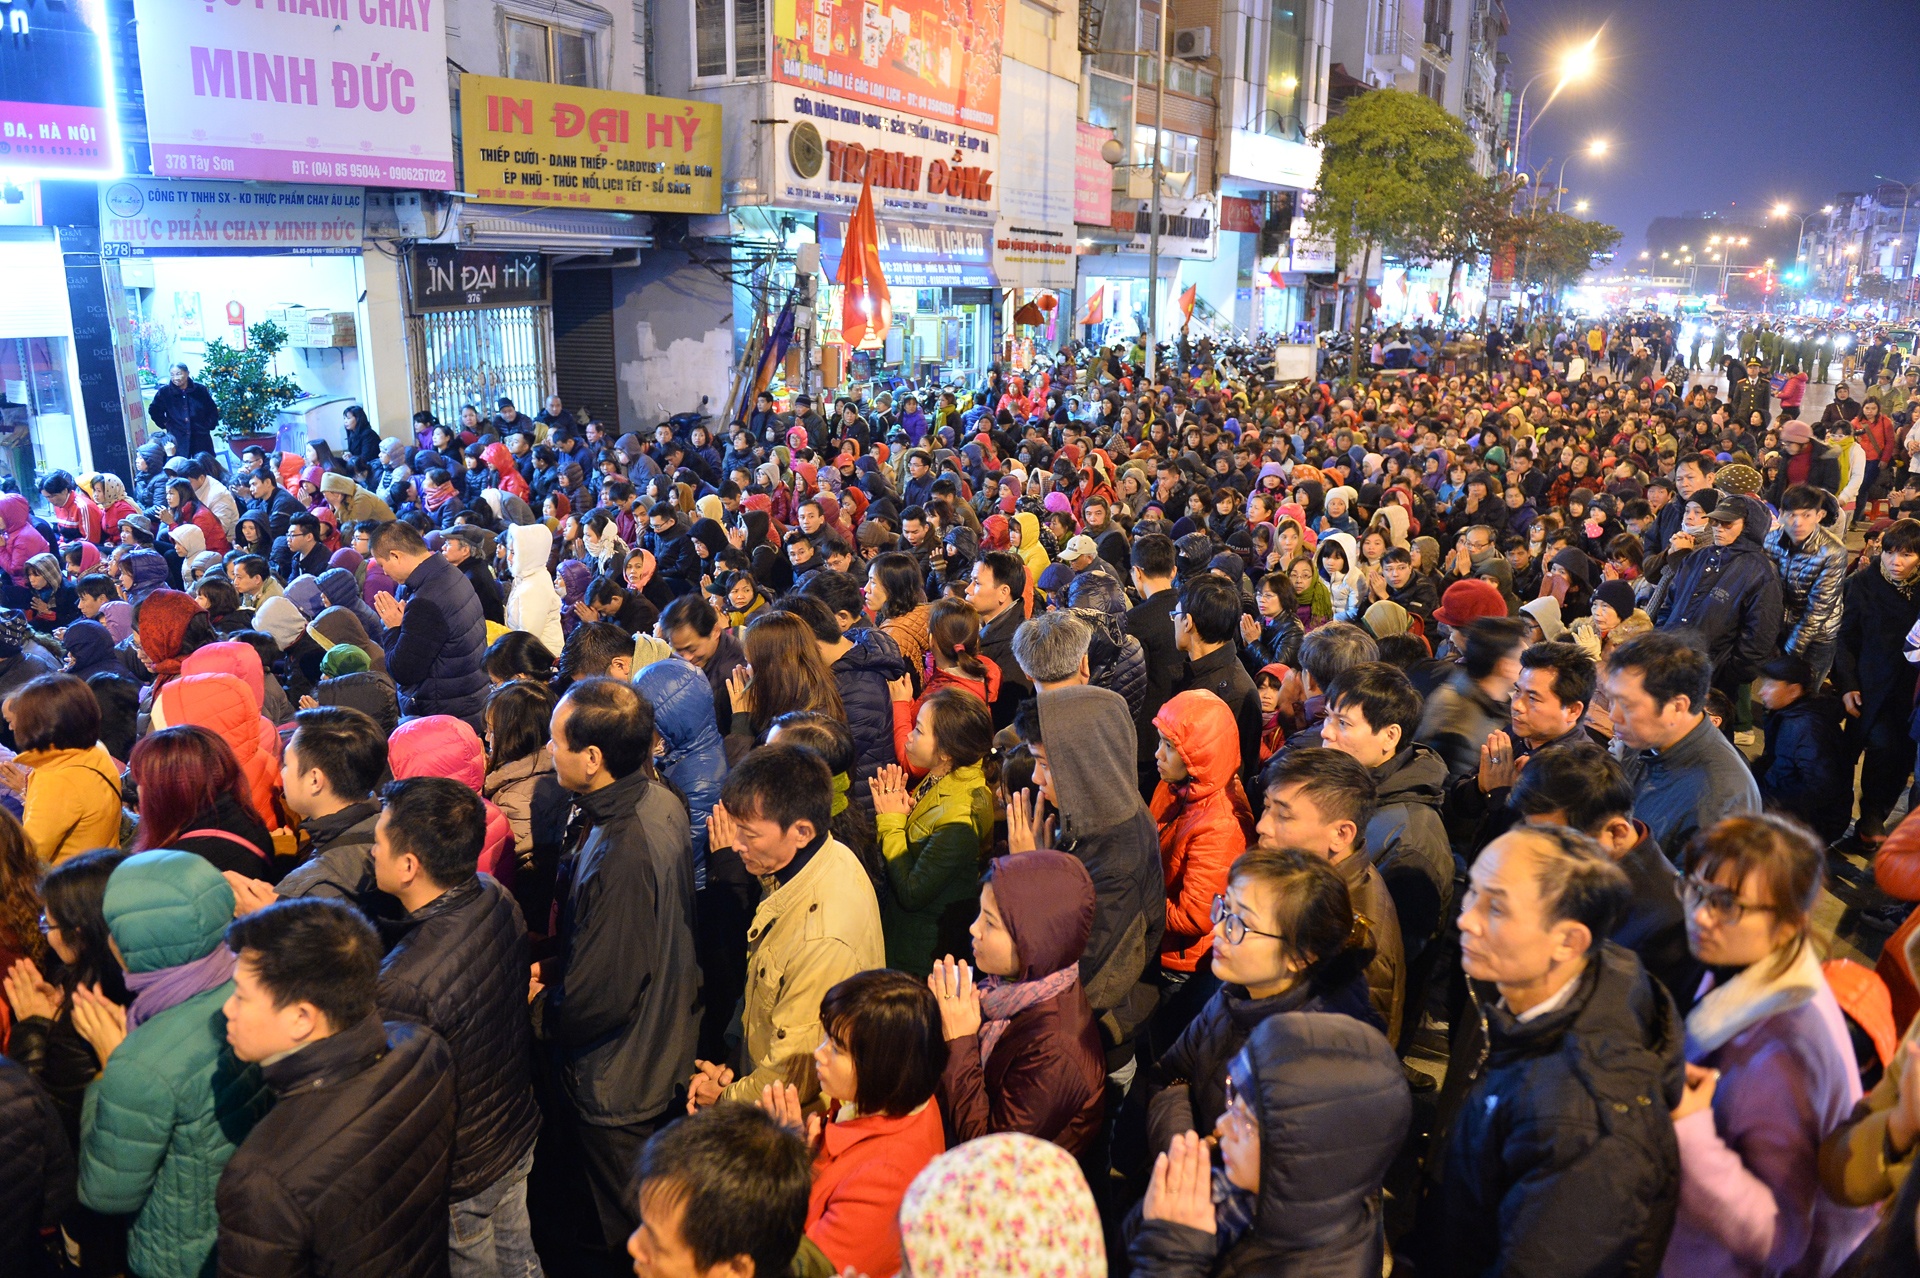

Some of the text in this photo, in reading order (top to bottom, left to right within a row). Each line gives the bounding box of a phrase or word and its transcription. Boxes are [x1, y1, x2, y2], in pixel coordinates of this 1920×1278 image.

[190, 46, 415, 115] MINH ĐỨC
[784, 59, 800, 76] BÁN
[828, 69, 843, 88] BÁN
[855, 76, 869, 94] CÁC
[4, 121, 97, 144] ĐA, HÀ NỘI
[487, 95, 700, 153] IN ĐẠI HỶ
[165, 154, 235, 172] 378 Tây Sơn
[480, 145, 510, 162] THIẾP
[514, 148, 539, 165] CƯỚI
[550, 155, 577, 169] DANH
[580, 153, 607, 170] THIẾP
[826, 139, 922, 191] TRANH
[292, 160, 447, 183] ĐT: (04) 85 95044 0906267022
[503, 168, 517, 184] ÉP
[553, 171, 578, 188] THÚC
[626, 176, 642, 192] TẾT
[667, 180, 691, 195] SÁCH
[148, 188, 175, 202] CÔNG
[177, 191, 188, 202] TY
[191, 191, 215, 203] TNHH
[218, 192, 231, 203] SX
[239, 193, 251, 203] KD
[254, 192, 276, 207] THỰC
[279, 190, 304, 205] PHẨM
[307, 194, 329, 205] CHAY
[344, 195, 360, 208] LẠC
[110, 208, 355, 246] THỰC PHẨM CHAY MINH ĐỨC
[104, 243, 130, 256] 378
[898, 226, 940, 256] TRANH,
[942, 229, 965, 259] LỊCH
[966, 232, 984, 256] 370
[426, 255, 536, 295] IN ĐẠI HỶ
[467, 293, 481, 303] 376
